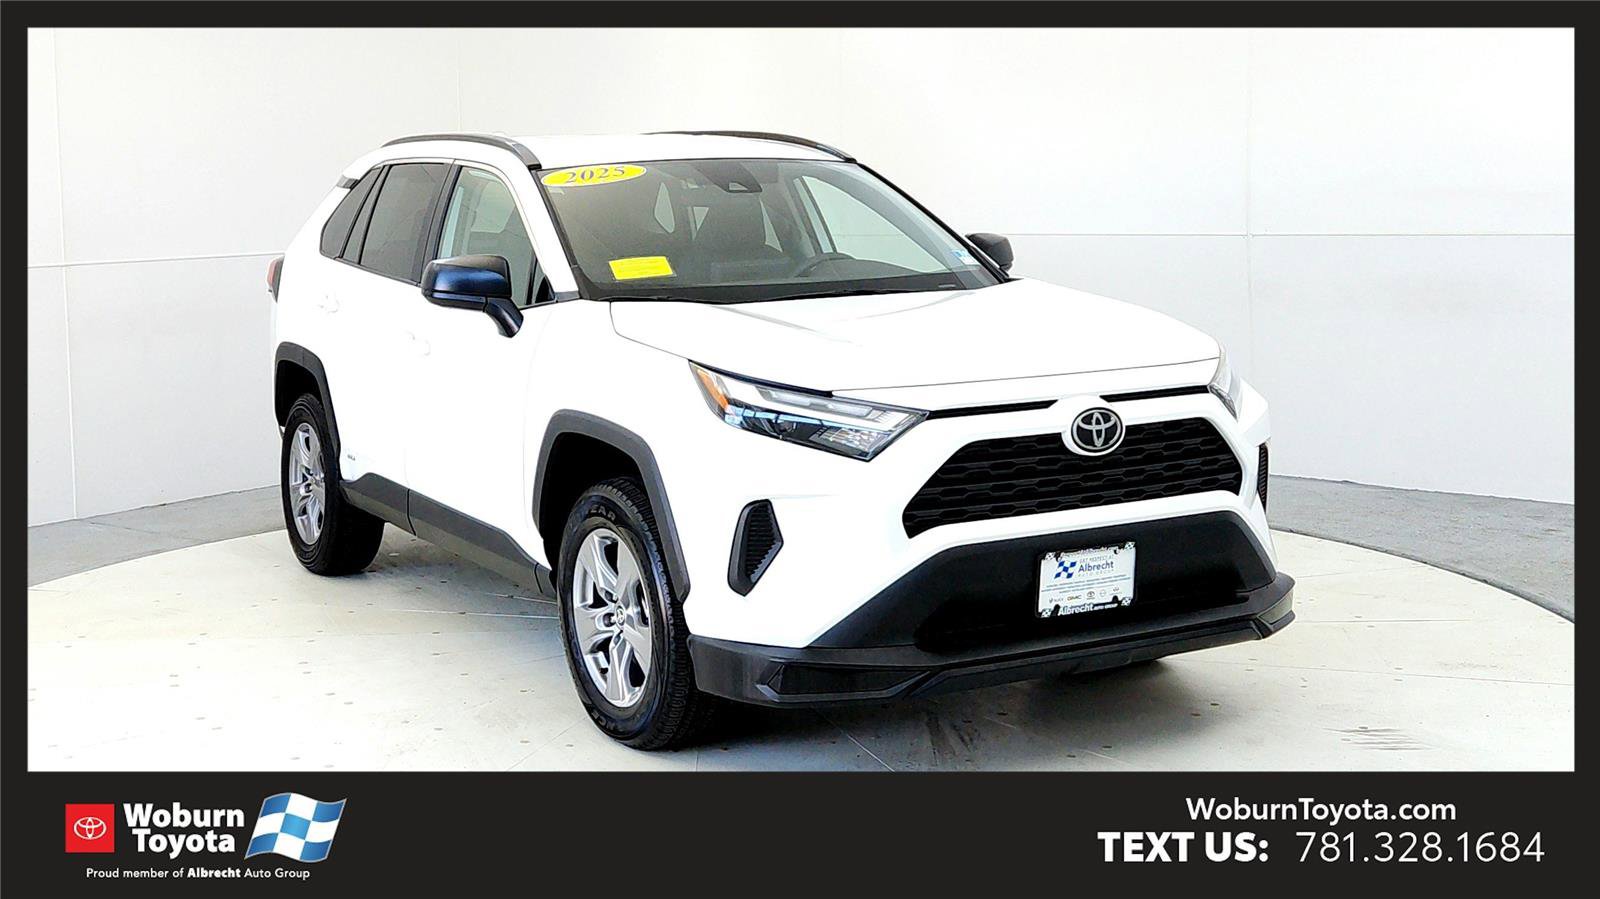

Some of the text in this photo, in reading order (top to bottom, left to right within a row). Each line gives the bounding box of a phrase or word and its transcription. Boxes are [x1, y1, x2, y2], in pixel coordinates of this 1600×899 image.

[564, 166, 625, 183] 2025
[1078, 560, 1114, 573] Albrecht
[1058, 602, 1094, 616] Albrecht
